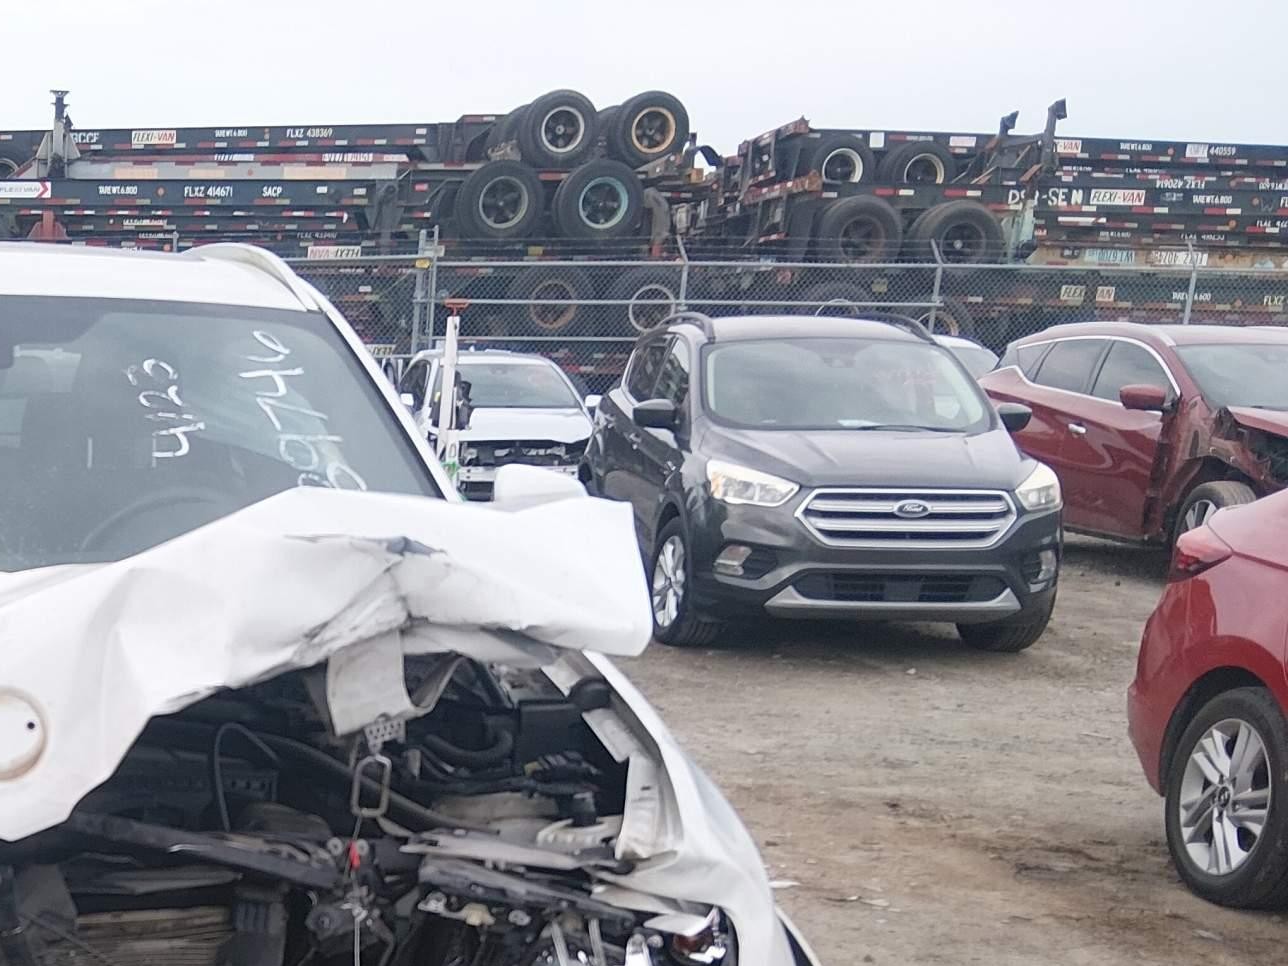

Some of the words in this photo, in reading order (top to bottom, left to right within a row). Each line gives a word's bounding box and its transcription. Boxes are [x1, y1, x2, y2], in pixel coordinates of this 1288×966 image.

[132, 131, 176, 143] FLEXI-VAN
[286, 128, 304, 138] FLXZ
[184, 186, 206, 198] FLXZ
[207, 186, 233, 198] 414671
[262, 186, 283, 198] SACP
[1091, 190, 1145, 204] FLEXI-VAN
[902, 503, 924, 512] Ford
